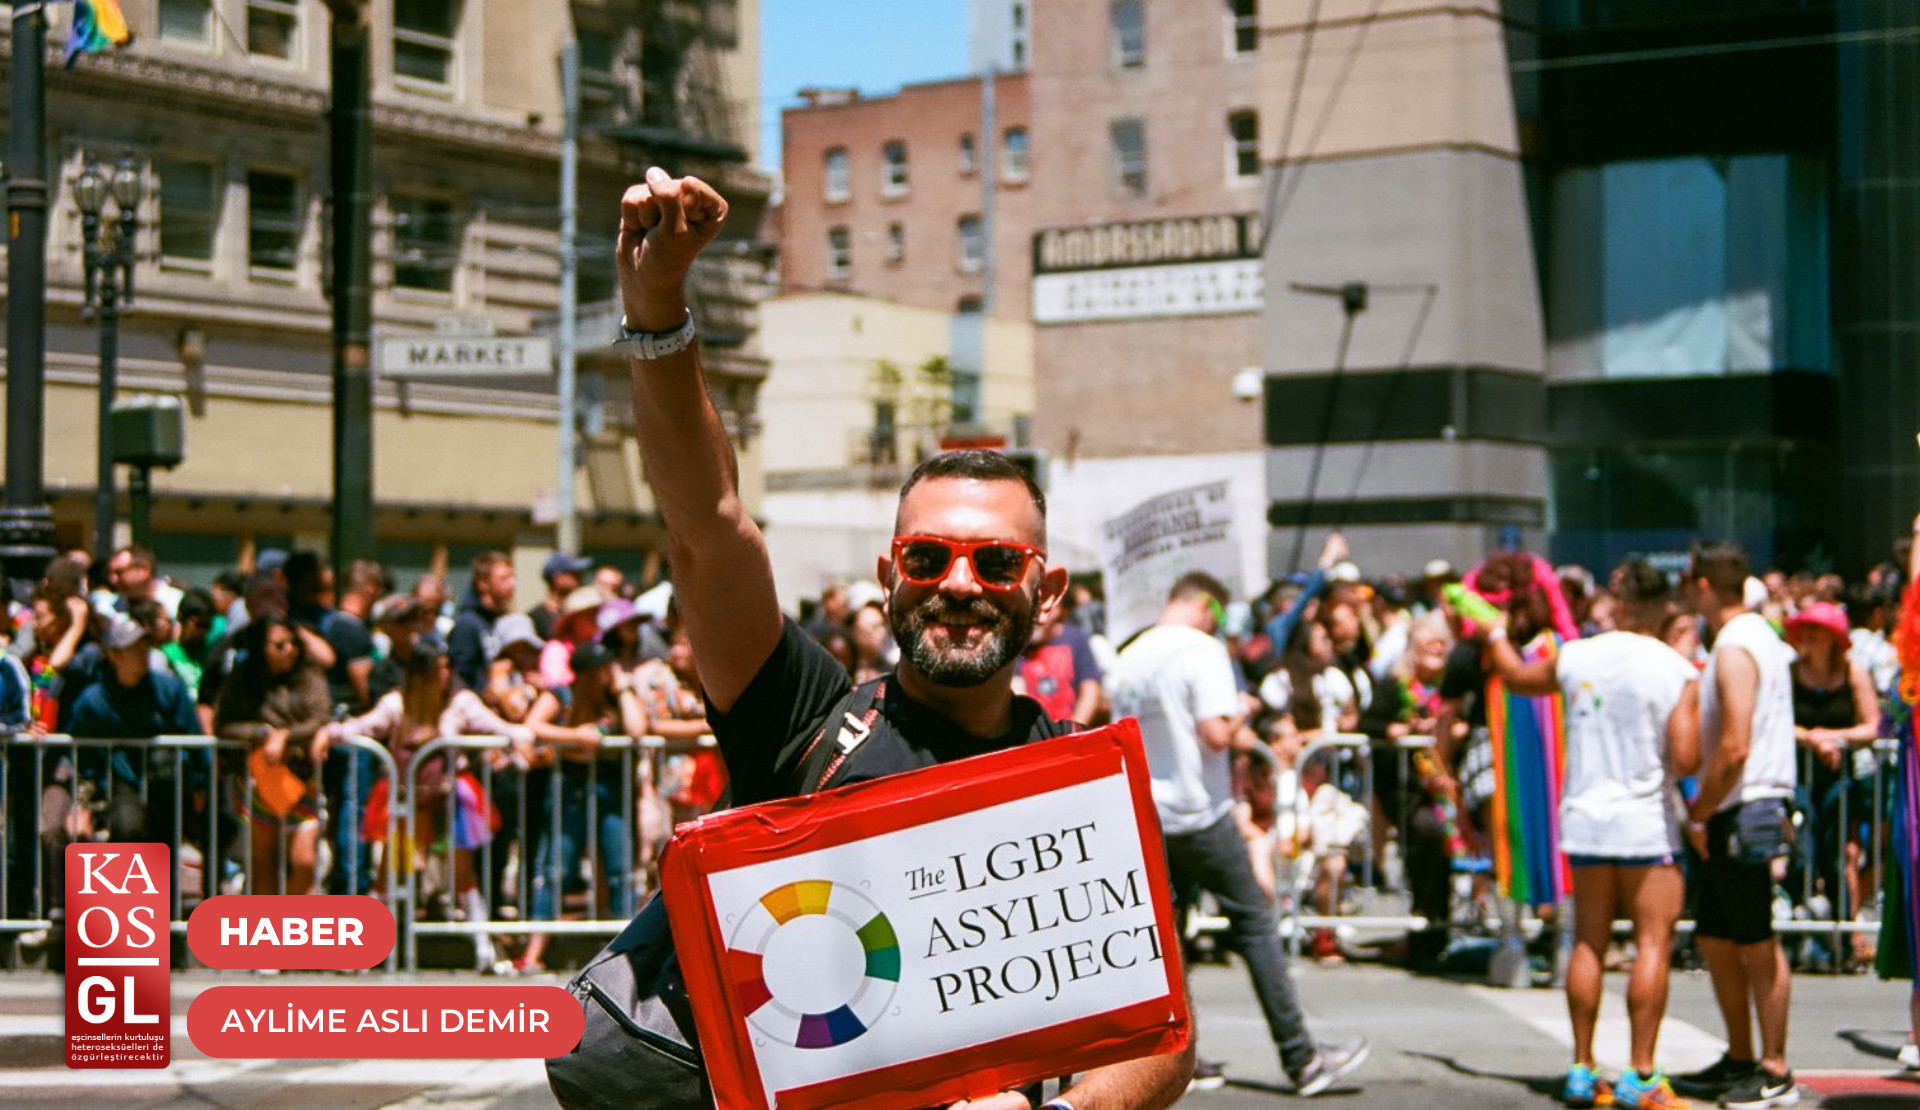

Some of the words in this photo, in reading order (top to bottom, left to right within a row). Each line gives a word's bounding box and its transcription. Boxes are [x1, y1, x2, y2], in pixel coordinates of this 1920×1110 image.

[408, 344, 525, 365] MARKET
[905, 866, 946, 892] The
[949, 821, 1097, 893] LGBT
[923, 869, 1146, 959] ASYLUM
[929, 923, 1164, 1014] PROJECT
